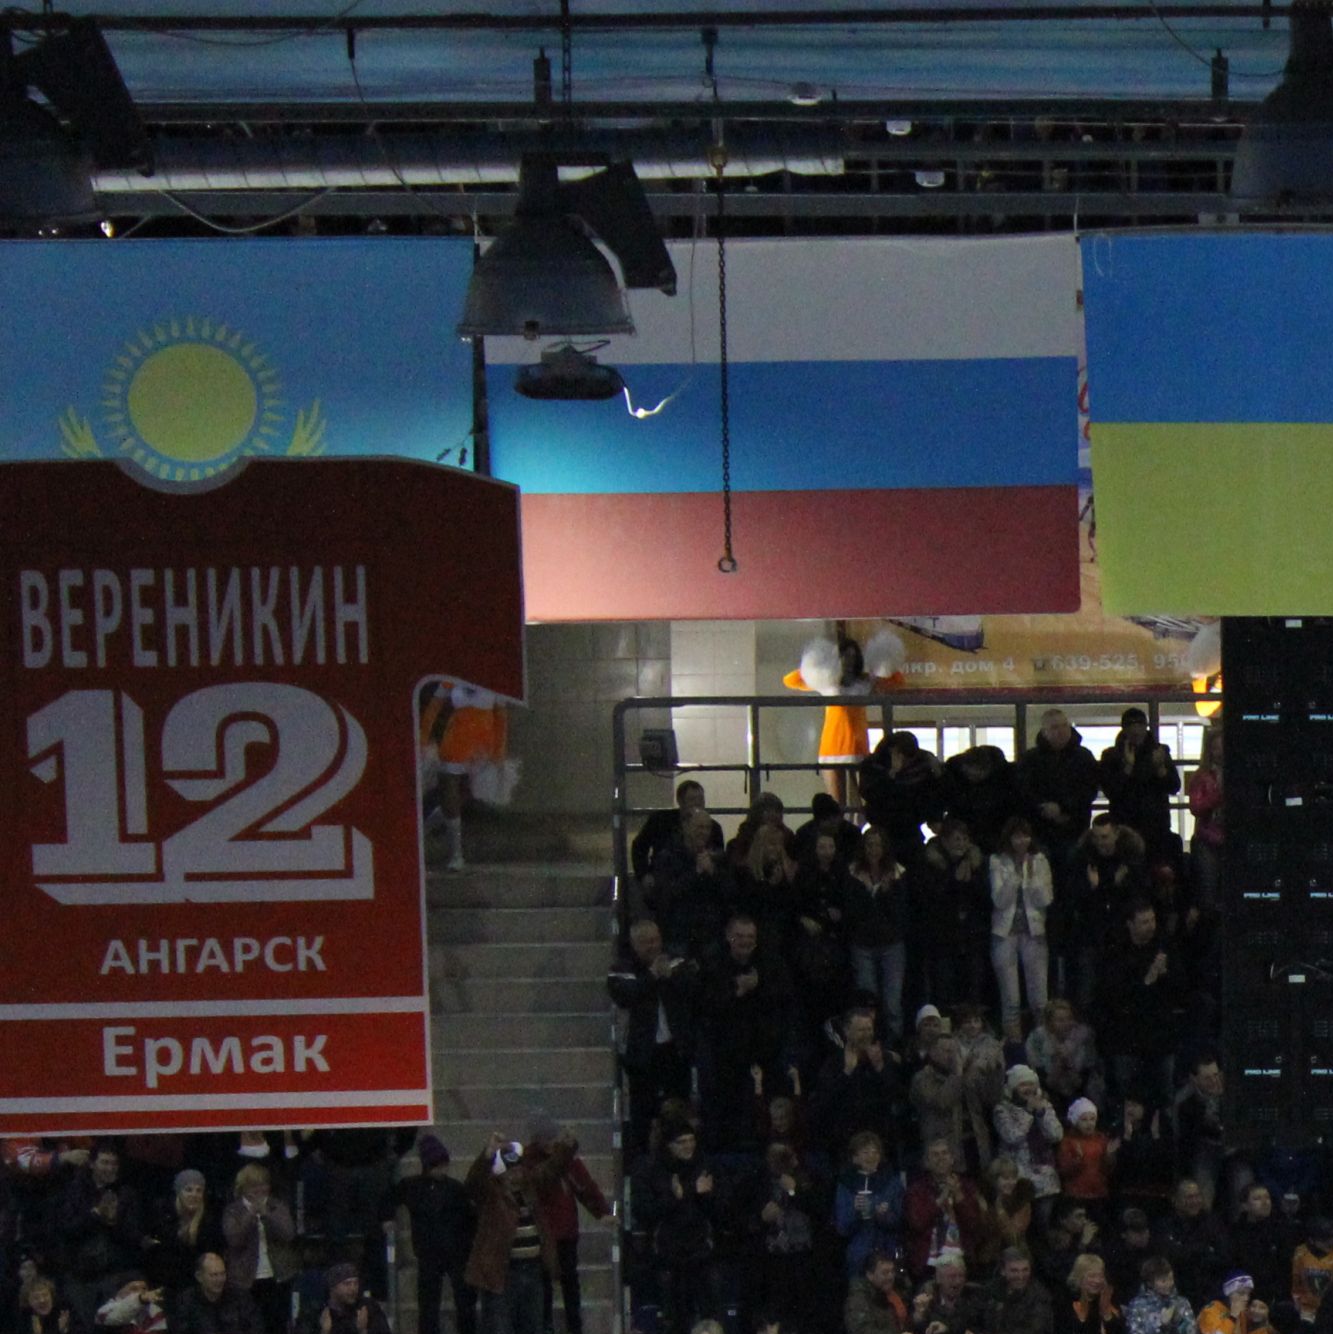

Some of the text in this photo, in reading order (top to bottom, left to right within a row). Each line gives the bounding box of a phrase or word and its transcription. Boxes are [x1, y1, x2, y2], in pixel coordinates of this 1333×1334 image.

[20, 564, 369, 669] ВЕРЕНИКИН
[951, 660, 994, 676] дом
[27, 681, 375, 905] 12
[100, 935, 327, 976] АНГАРСК
[102, 1025, 330, 1089] Ермак
